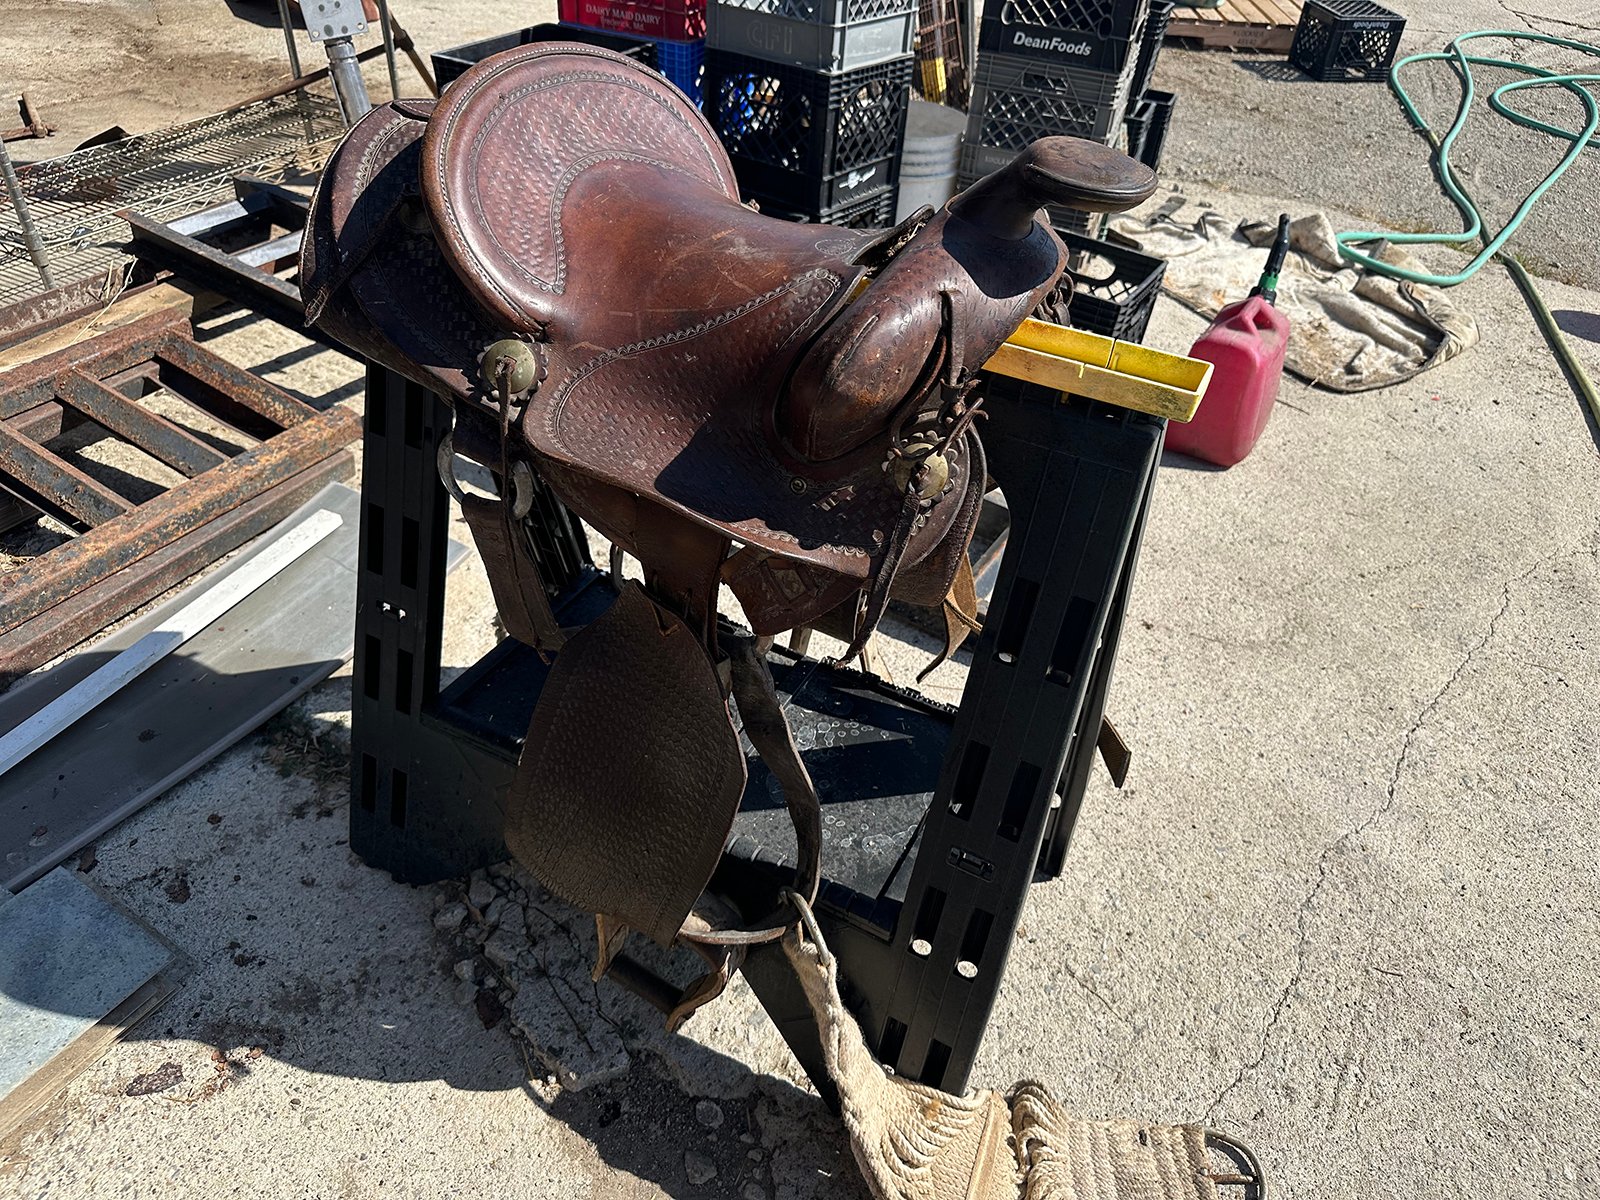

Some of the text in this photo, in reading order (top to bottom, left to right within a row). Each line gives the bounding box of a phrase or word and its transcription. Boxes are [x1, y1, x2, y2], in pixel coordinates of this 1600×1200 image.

[585, 4, 661, 25] DAIRY MAID DAIRY
[746, 20, 792, 55] CFI
[1013, 31, 1092, 56] DeanFoods
